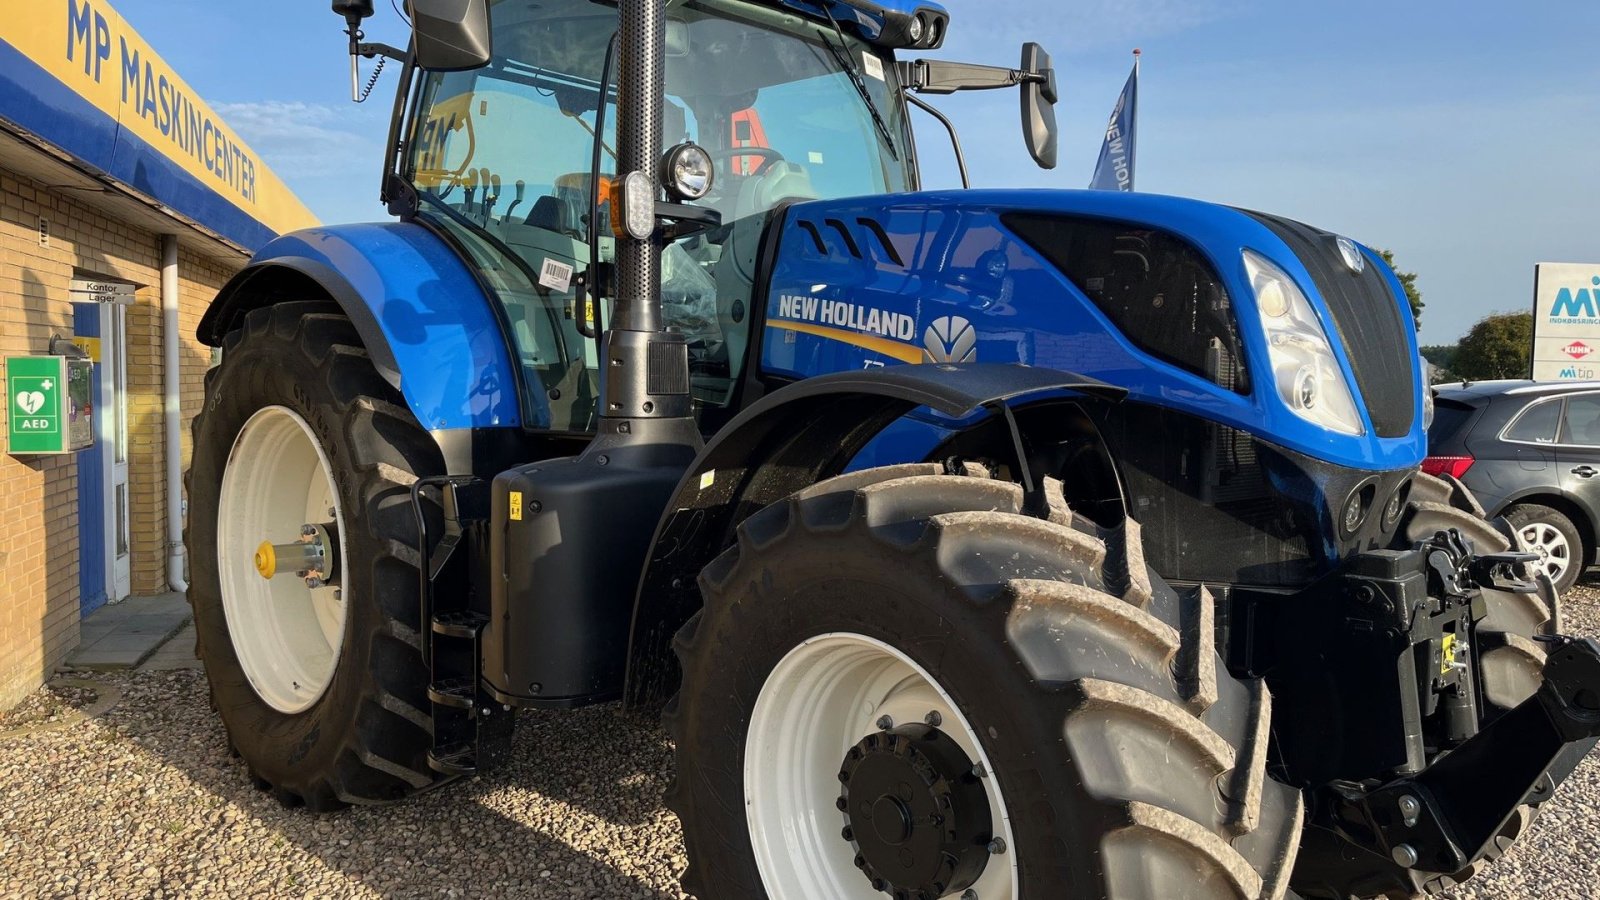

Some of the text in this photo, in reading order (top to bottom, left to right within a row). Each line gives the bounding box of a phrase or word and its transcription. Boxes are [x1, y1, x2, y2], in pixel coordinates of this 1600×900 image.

[66, 0, 256, 204] MP MASKINCENTER
[1113, 156, 1129, 192] HOL
[87, 283, 117, 292] Kontor
[89, 294, 116, 303] Lager
[779, 295, 818, 321] NEW
[821, 300, 914, 341] HOLLAND
[1565, 346, 1590, 354] KUHN
[1578, 366, 1594, 379] tip
[22, 420, 49, 429] AED
